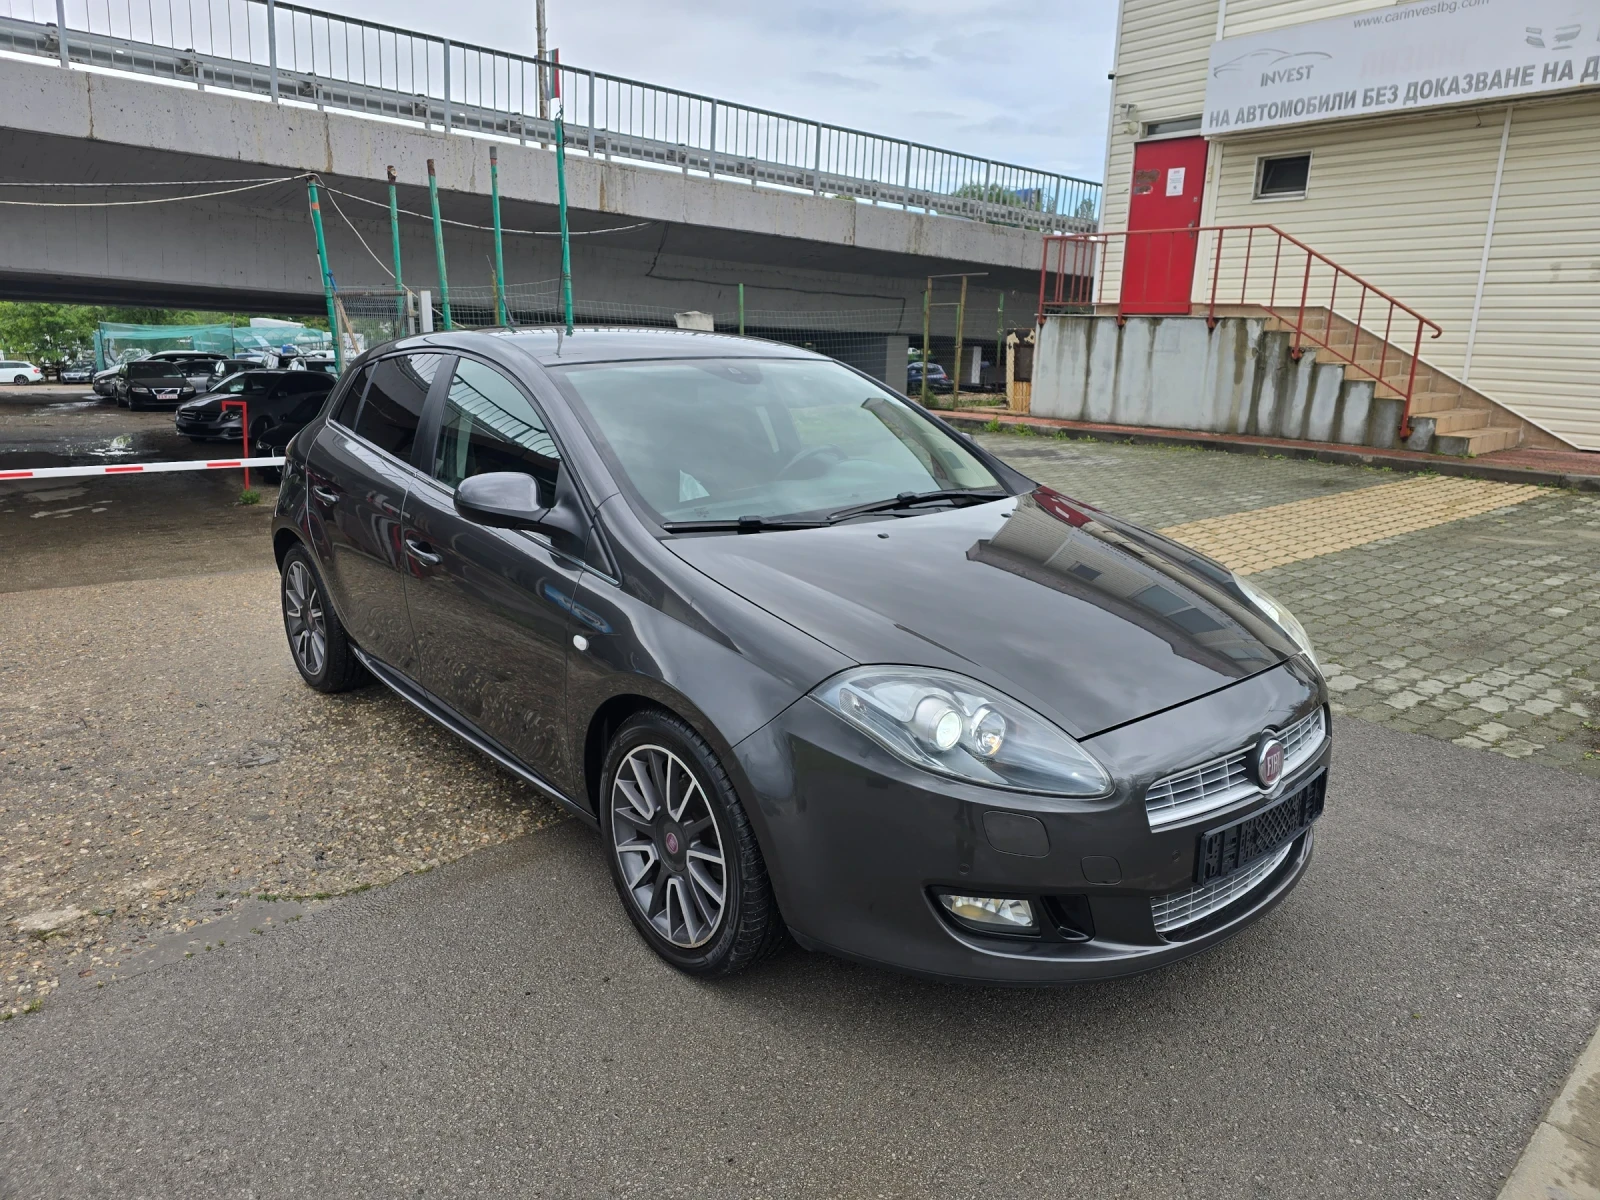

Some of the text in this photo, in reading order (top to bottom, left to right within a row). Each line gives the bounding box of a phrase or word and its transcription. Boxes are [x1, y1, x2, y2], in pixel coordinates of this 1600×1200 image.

[1353, 0, 1490, 28] www.carinvestbg.com
[1260, 65, 1314, 87] INVEST
[1209, 109, 1230, 128] НА
[1234, 90, 1357, 125] АВТОМОБИЛИ
[1362, 84, 1399, 107] БЕЗ
[1403, 64, 1536, 106] ДОКАЗВАНЕ
[1541, 59, 1574, 84] НА
[1266, 751, 1281, 777] FIAT
